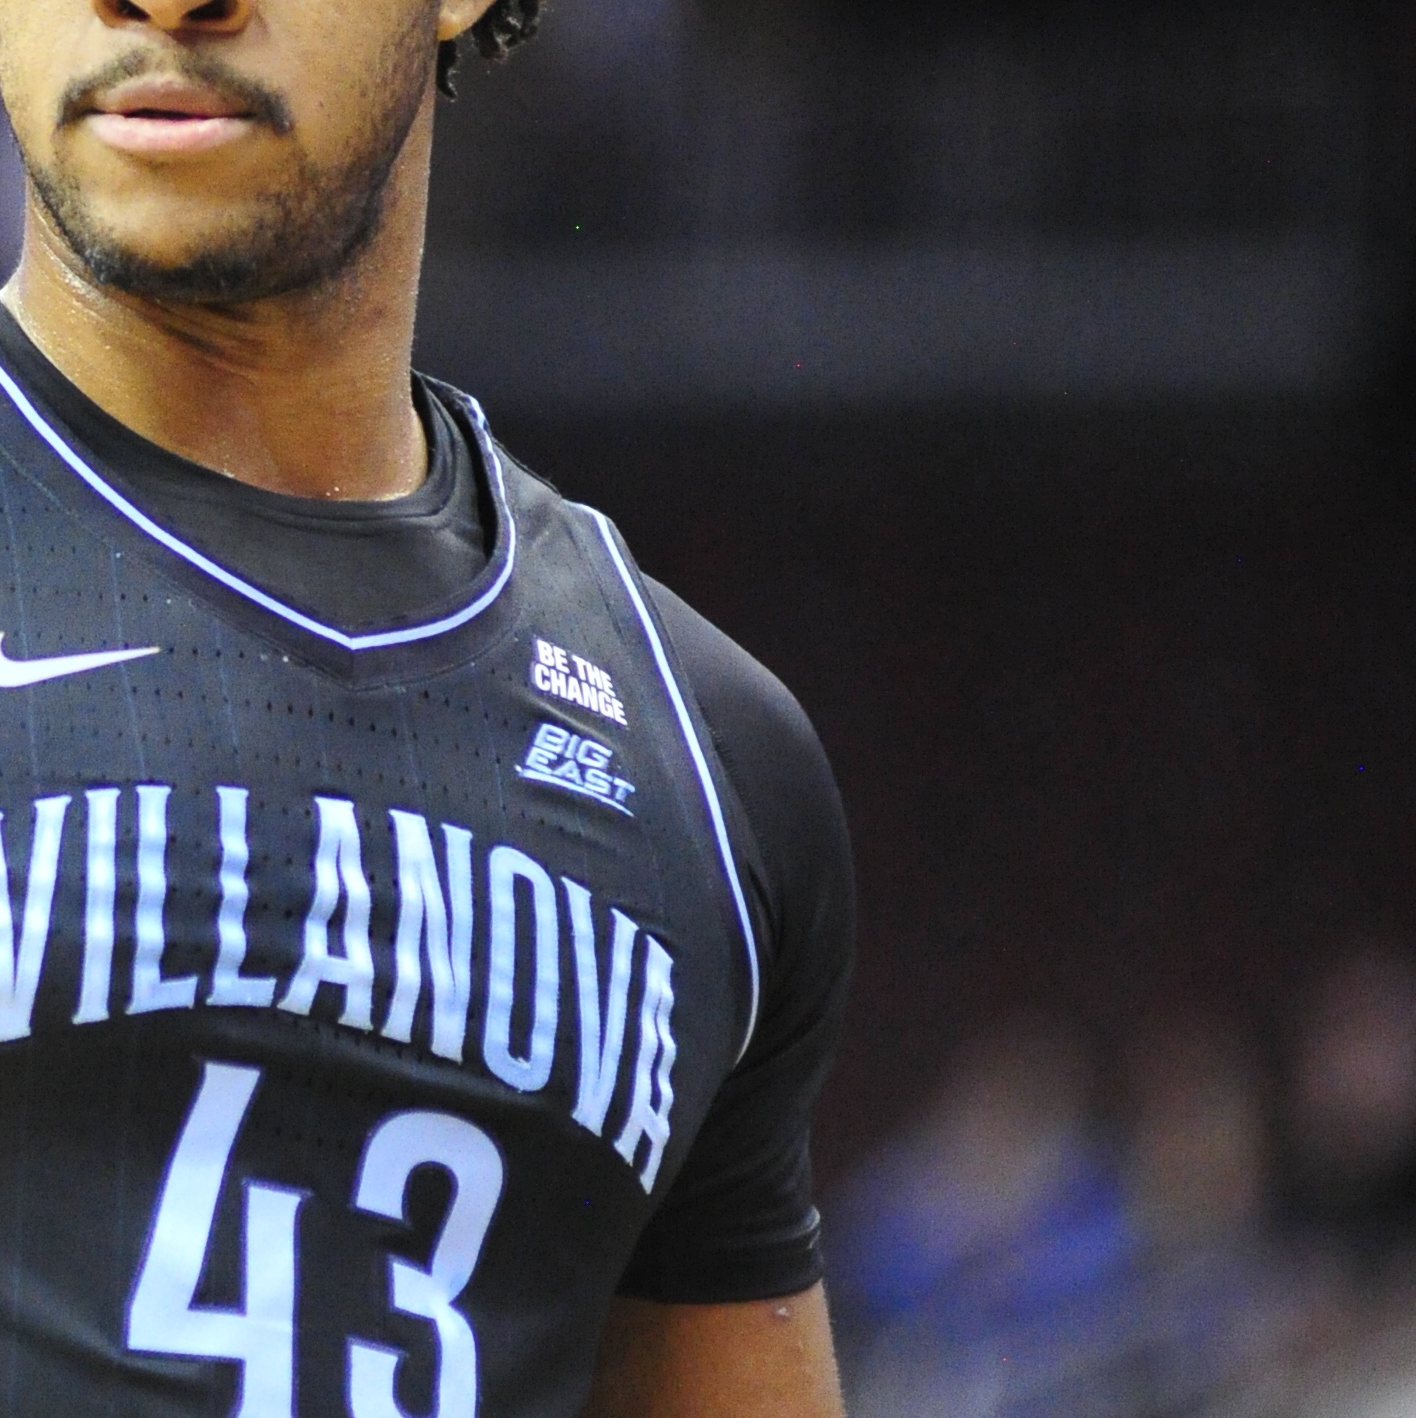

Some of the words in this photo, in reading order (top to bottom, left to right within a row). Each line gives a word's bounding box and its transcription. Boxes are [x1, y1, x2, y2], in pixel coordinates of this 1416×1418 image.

[533, 663, 628, 726] CHANGE
[535, 638, 570, 675] BE
[571, 653, 616, 698] THE
[525, 746, 635, 803] EAST
[534, 723, 613, 769] BIG
